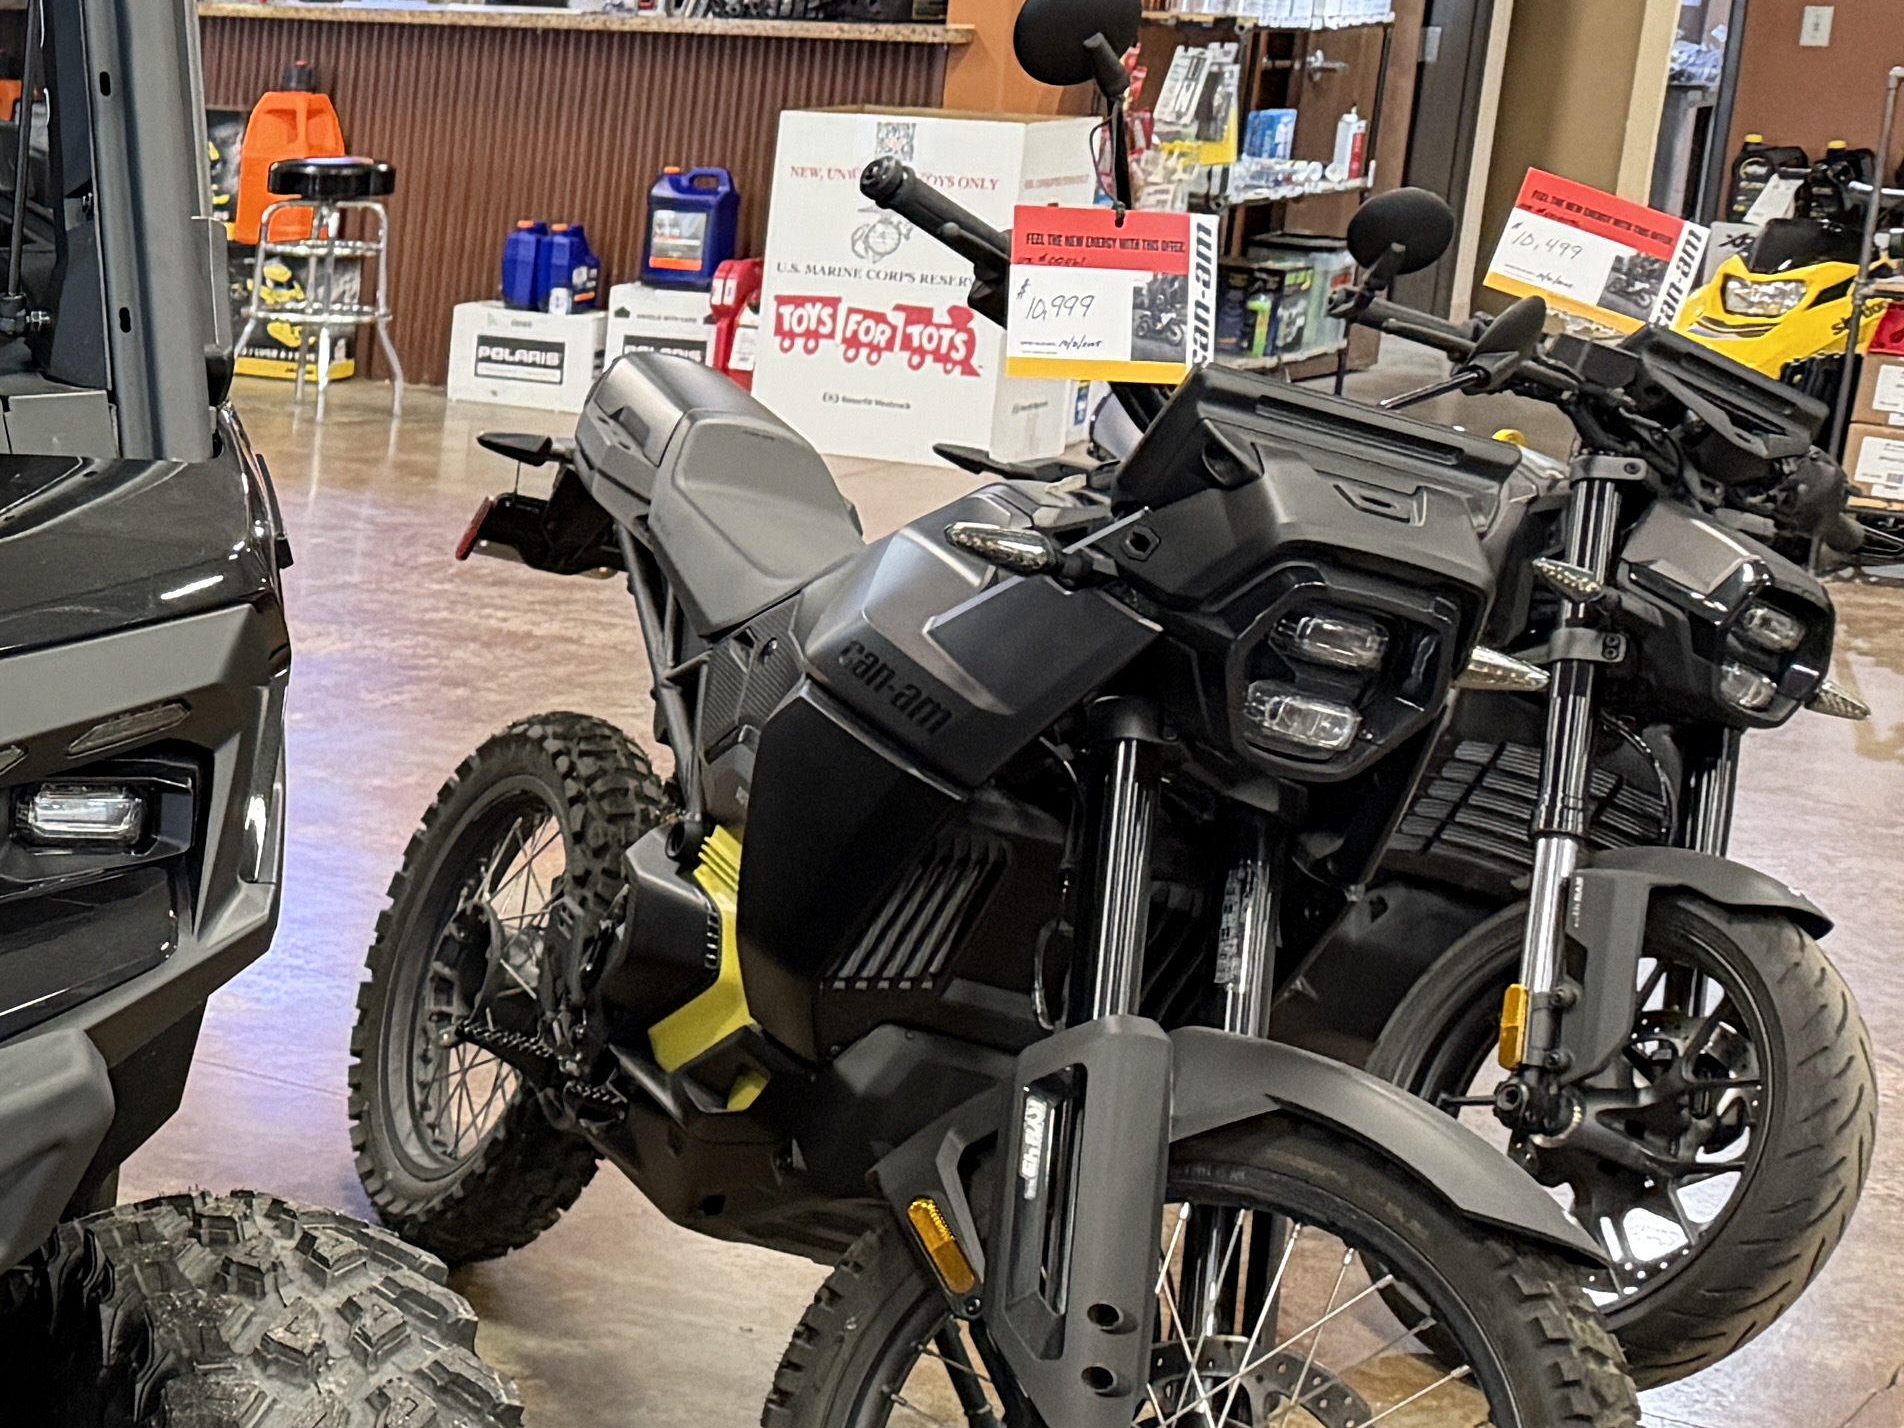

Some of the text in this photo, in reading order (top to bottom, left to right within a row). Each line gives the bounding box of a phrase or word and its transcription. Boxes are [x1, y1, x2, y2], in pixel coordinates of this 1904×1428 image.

[958, 176, 1000, 191] ONLY
[804, 264, 862, 280] MARINE
[866, 269, 916, 284] CORPS
[778, 302, 968, 362] TOYS FOR TOTS
[477, 345, 562, 367] POLARIS
[839, 639, 953, 735] can-am
